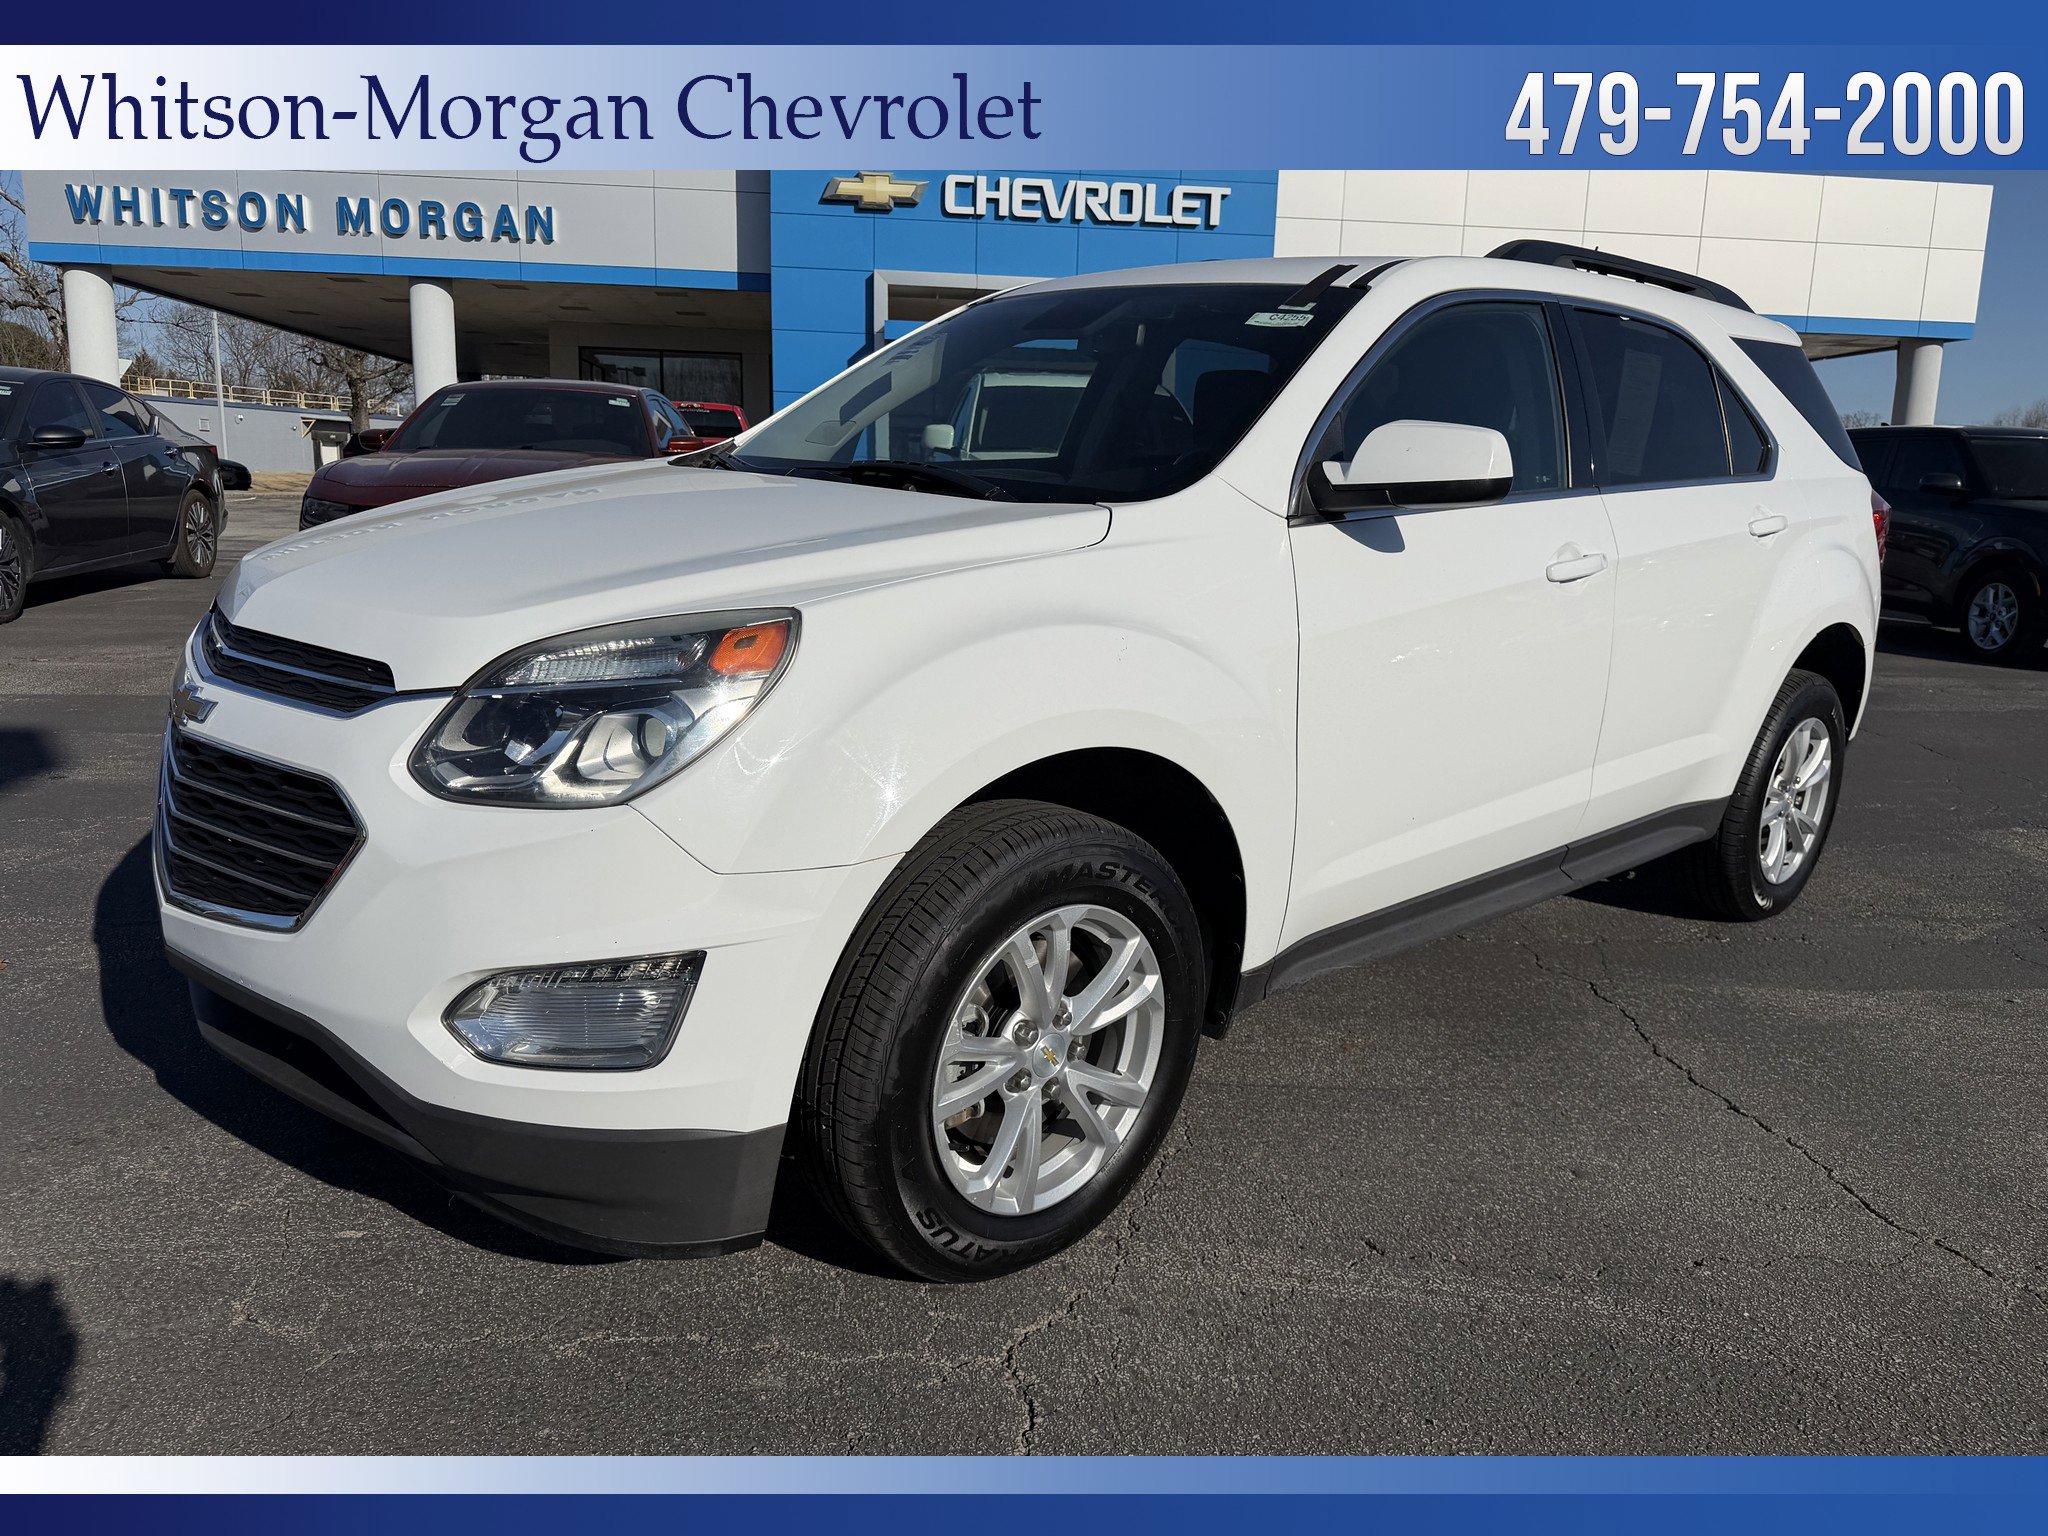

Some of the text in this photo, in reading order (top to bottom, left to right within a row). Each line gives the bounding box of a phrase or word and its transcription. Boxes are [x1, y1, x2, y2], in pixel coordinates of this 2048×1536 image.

[65, 183, 556, 244] WHITSON MORGAN
[941, 174, 1231, 228] CHEVROLET
